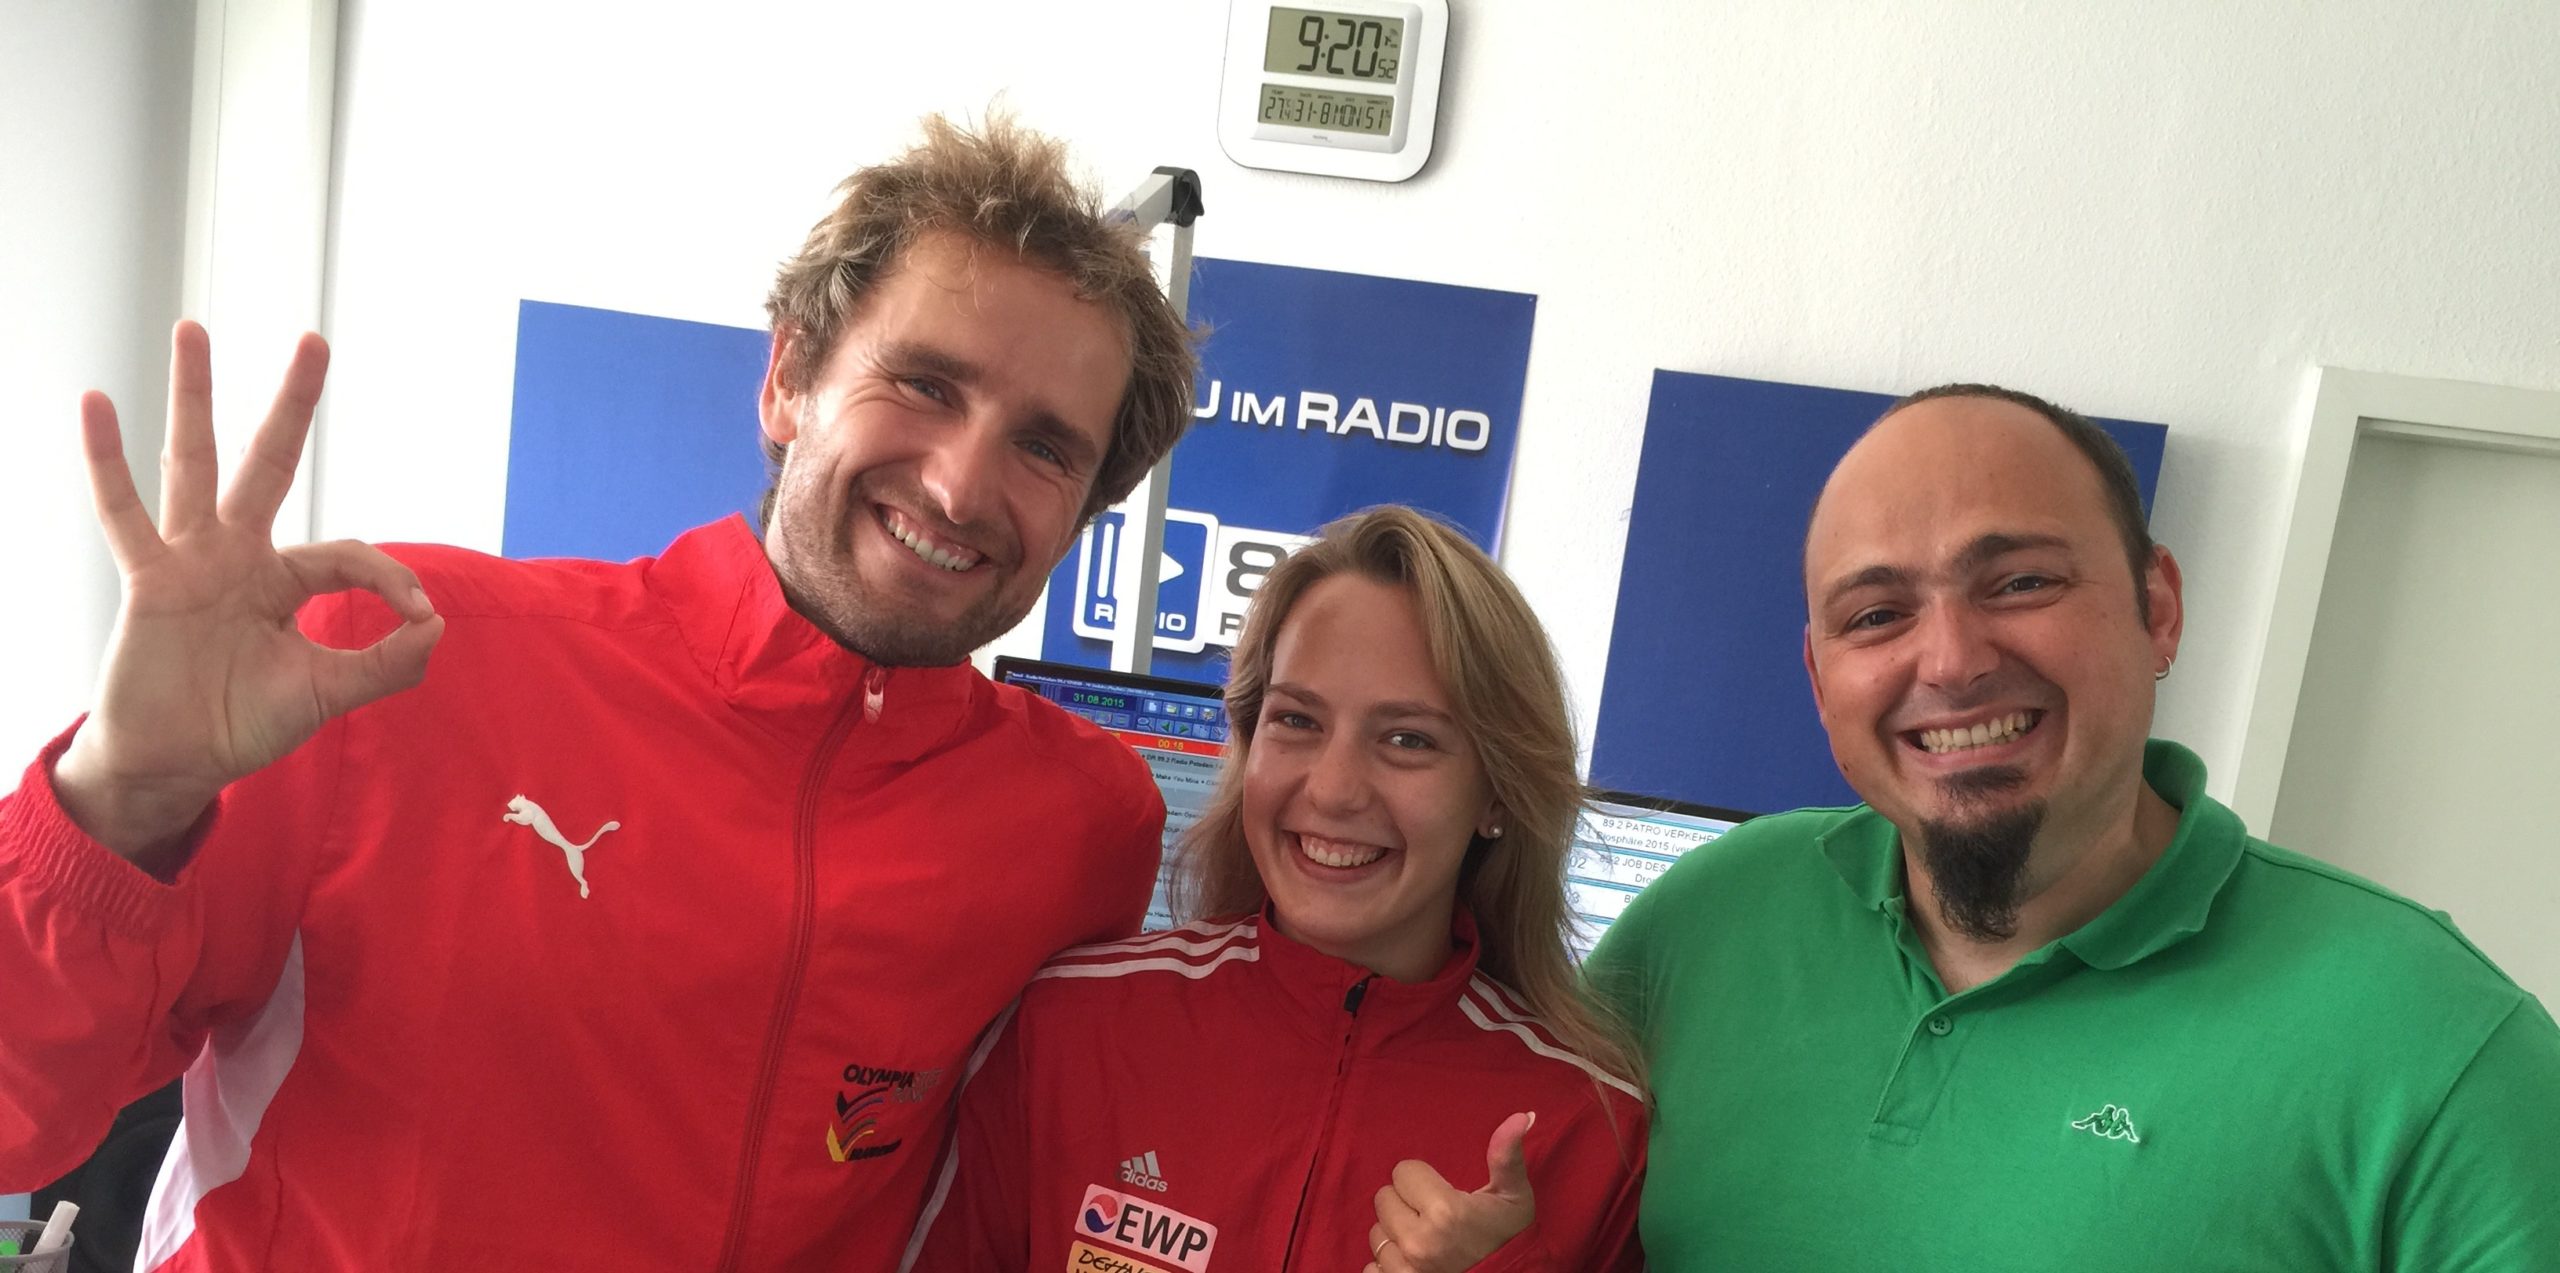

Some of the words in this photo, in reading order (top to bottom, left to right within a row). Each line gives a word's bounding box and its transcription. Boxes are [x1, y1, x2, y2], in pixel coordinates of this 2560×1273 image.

[1297, 15, 1382, 77] 9:20
[1231, 391, 1286, 427] IM
[1297, 391, 1490, 451] RADIO
[1094, 603, 1186, 632] RIO
[1625, 821, 1661, 836] PATRO
[1645, 839, 1669, 850] 2015
[1622, 859, 1642, 869] JOB
[1645, 861, 1667, 873] DES
[1115, 1203, 1208, 1262] EWP
